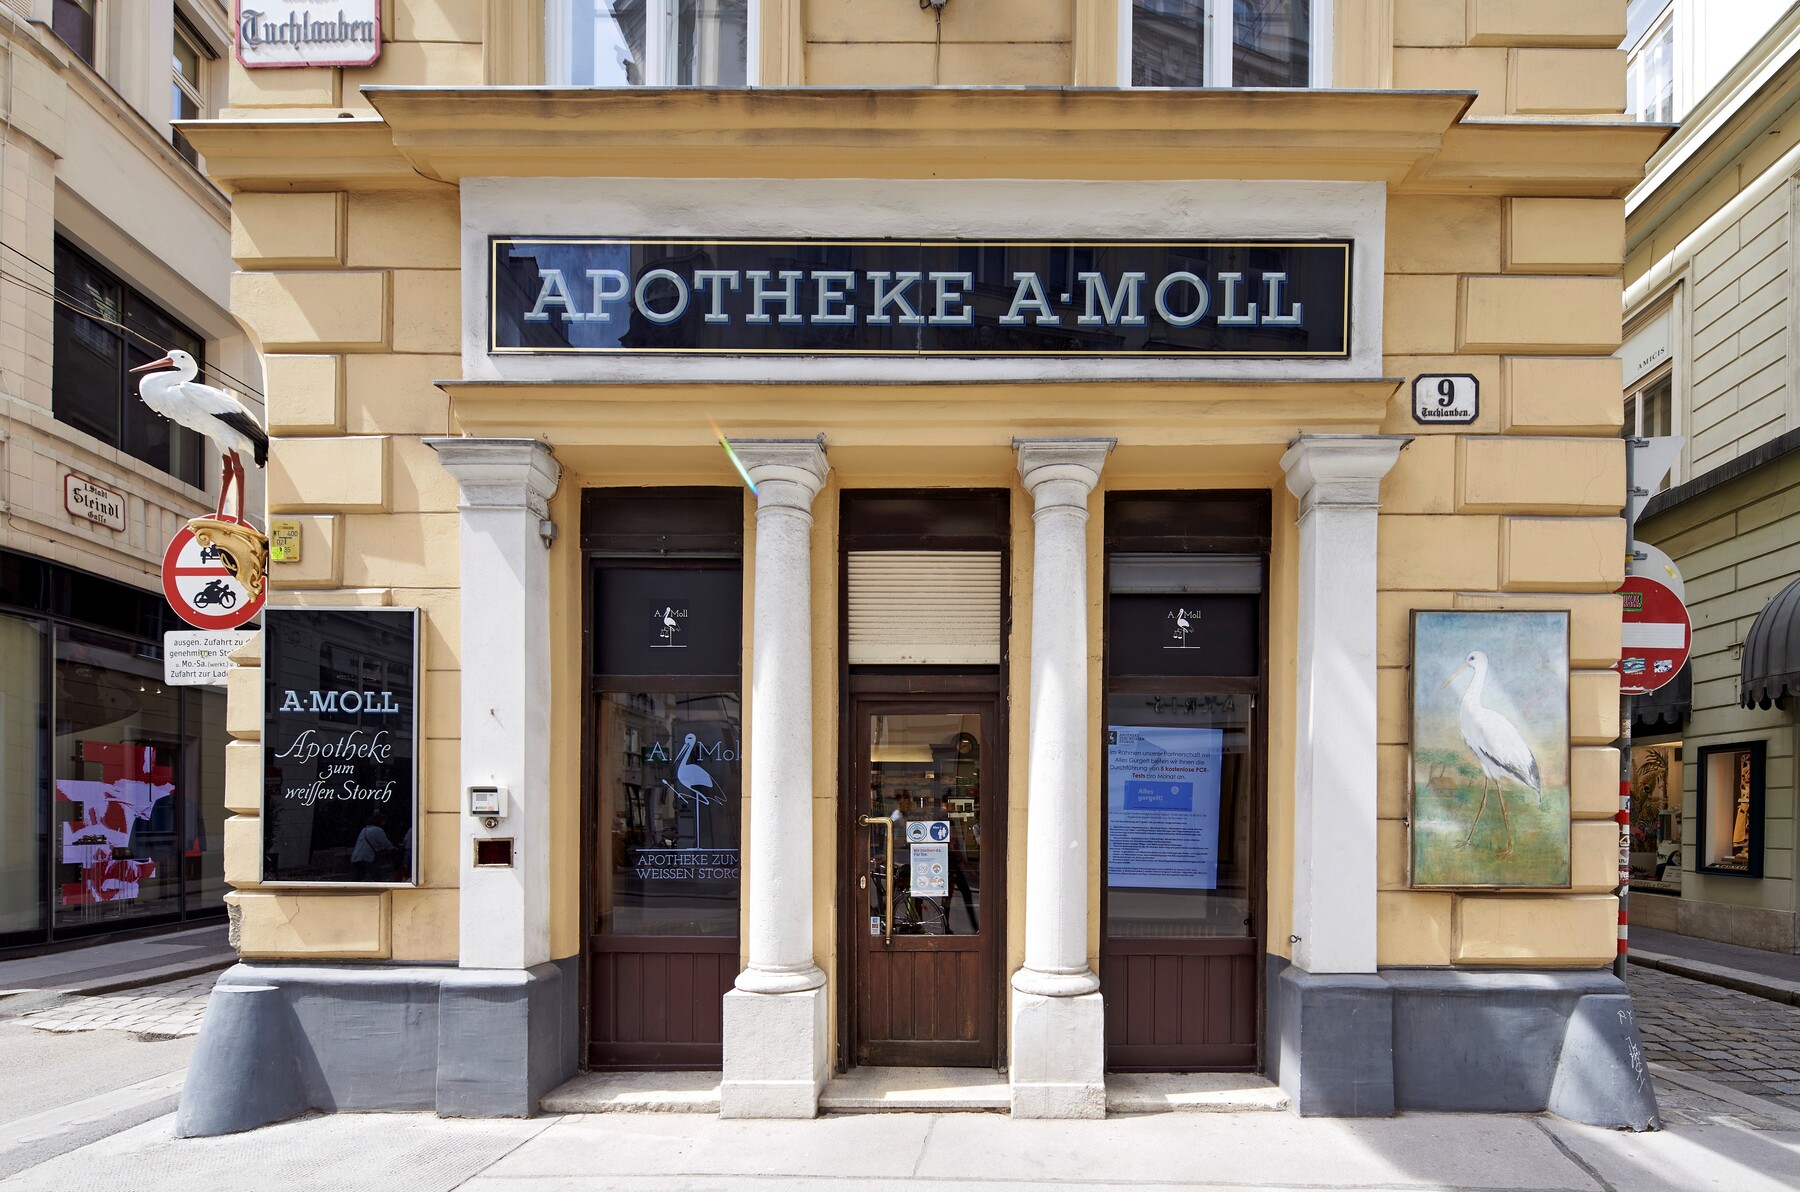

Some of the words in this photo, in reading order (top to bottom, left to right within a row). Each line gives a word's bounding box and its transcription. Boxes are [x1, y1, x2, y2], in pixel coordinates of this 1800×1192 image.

[241, 9, 374, 51] Tuchlauben
[523, 268, 974, 326] APOTHEKE
[1638, 346, 1665, 370] AMICIS
[1438, 378, 1454, 407] 9
[73, 488, 119, 519] Steindl
[670, 609, 688, 618] Moll
[1183, 610, 1202, 618] Moll
[274, 730, 392, 764] Apotheke
[697, 740, 740, 761] Mol
[319, 764, 355, 780] zum
[337, 780, 396, 803] Storch
[638, 854, 708, 866] APOTHEKE
[636, 868, 694, 879] WEISSEN
[698, 868, 738, 879] STORC
